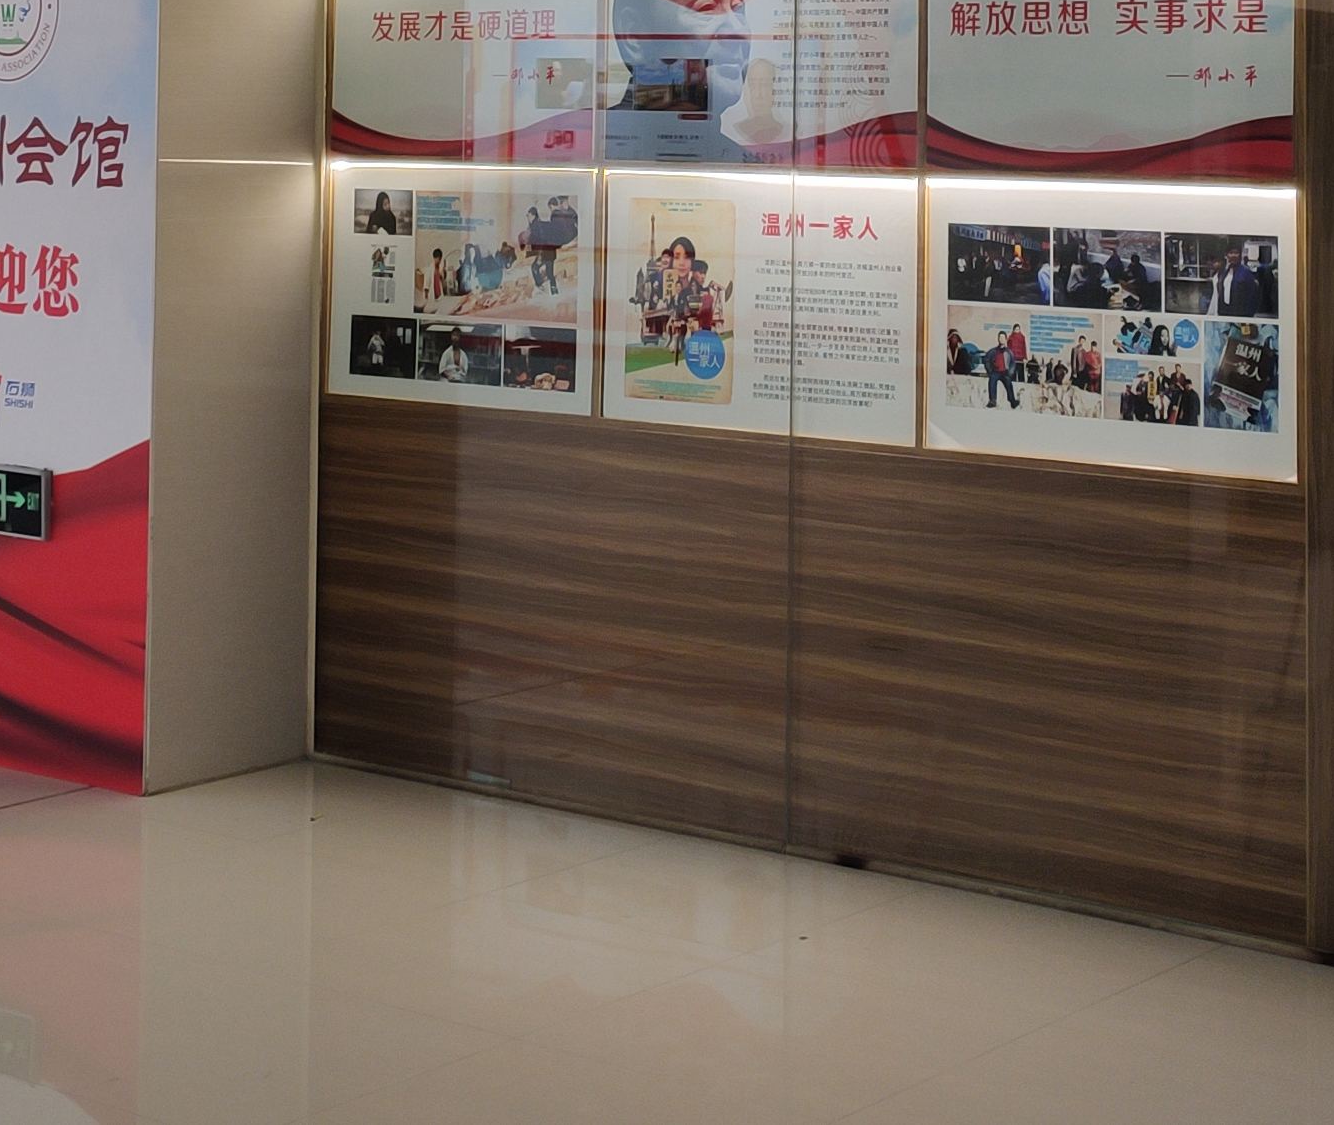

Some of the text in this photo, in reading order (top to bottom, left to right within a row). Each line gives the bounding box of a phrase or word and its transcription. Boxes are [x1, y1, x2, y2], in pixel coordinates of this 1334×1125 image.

[371, 9, 556, 43] 发展才是硬道理
[1, 22, 51, 73] ASSOCIATION
[761, 213, 879, 242] 温州一家人
[4, 397, 35, 410] SHISHI
